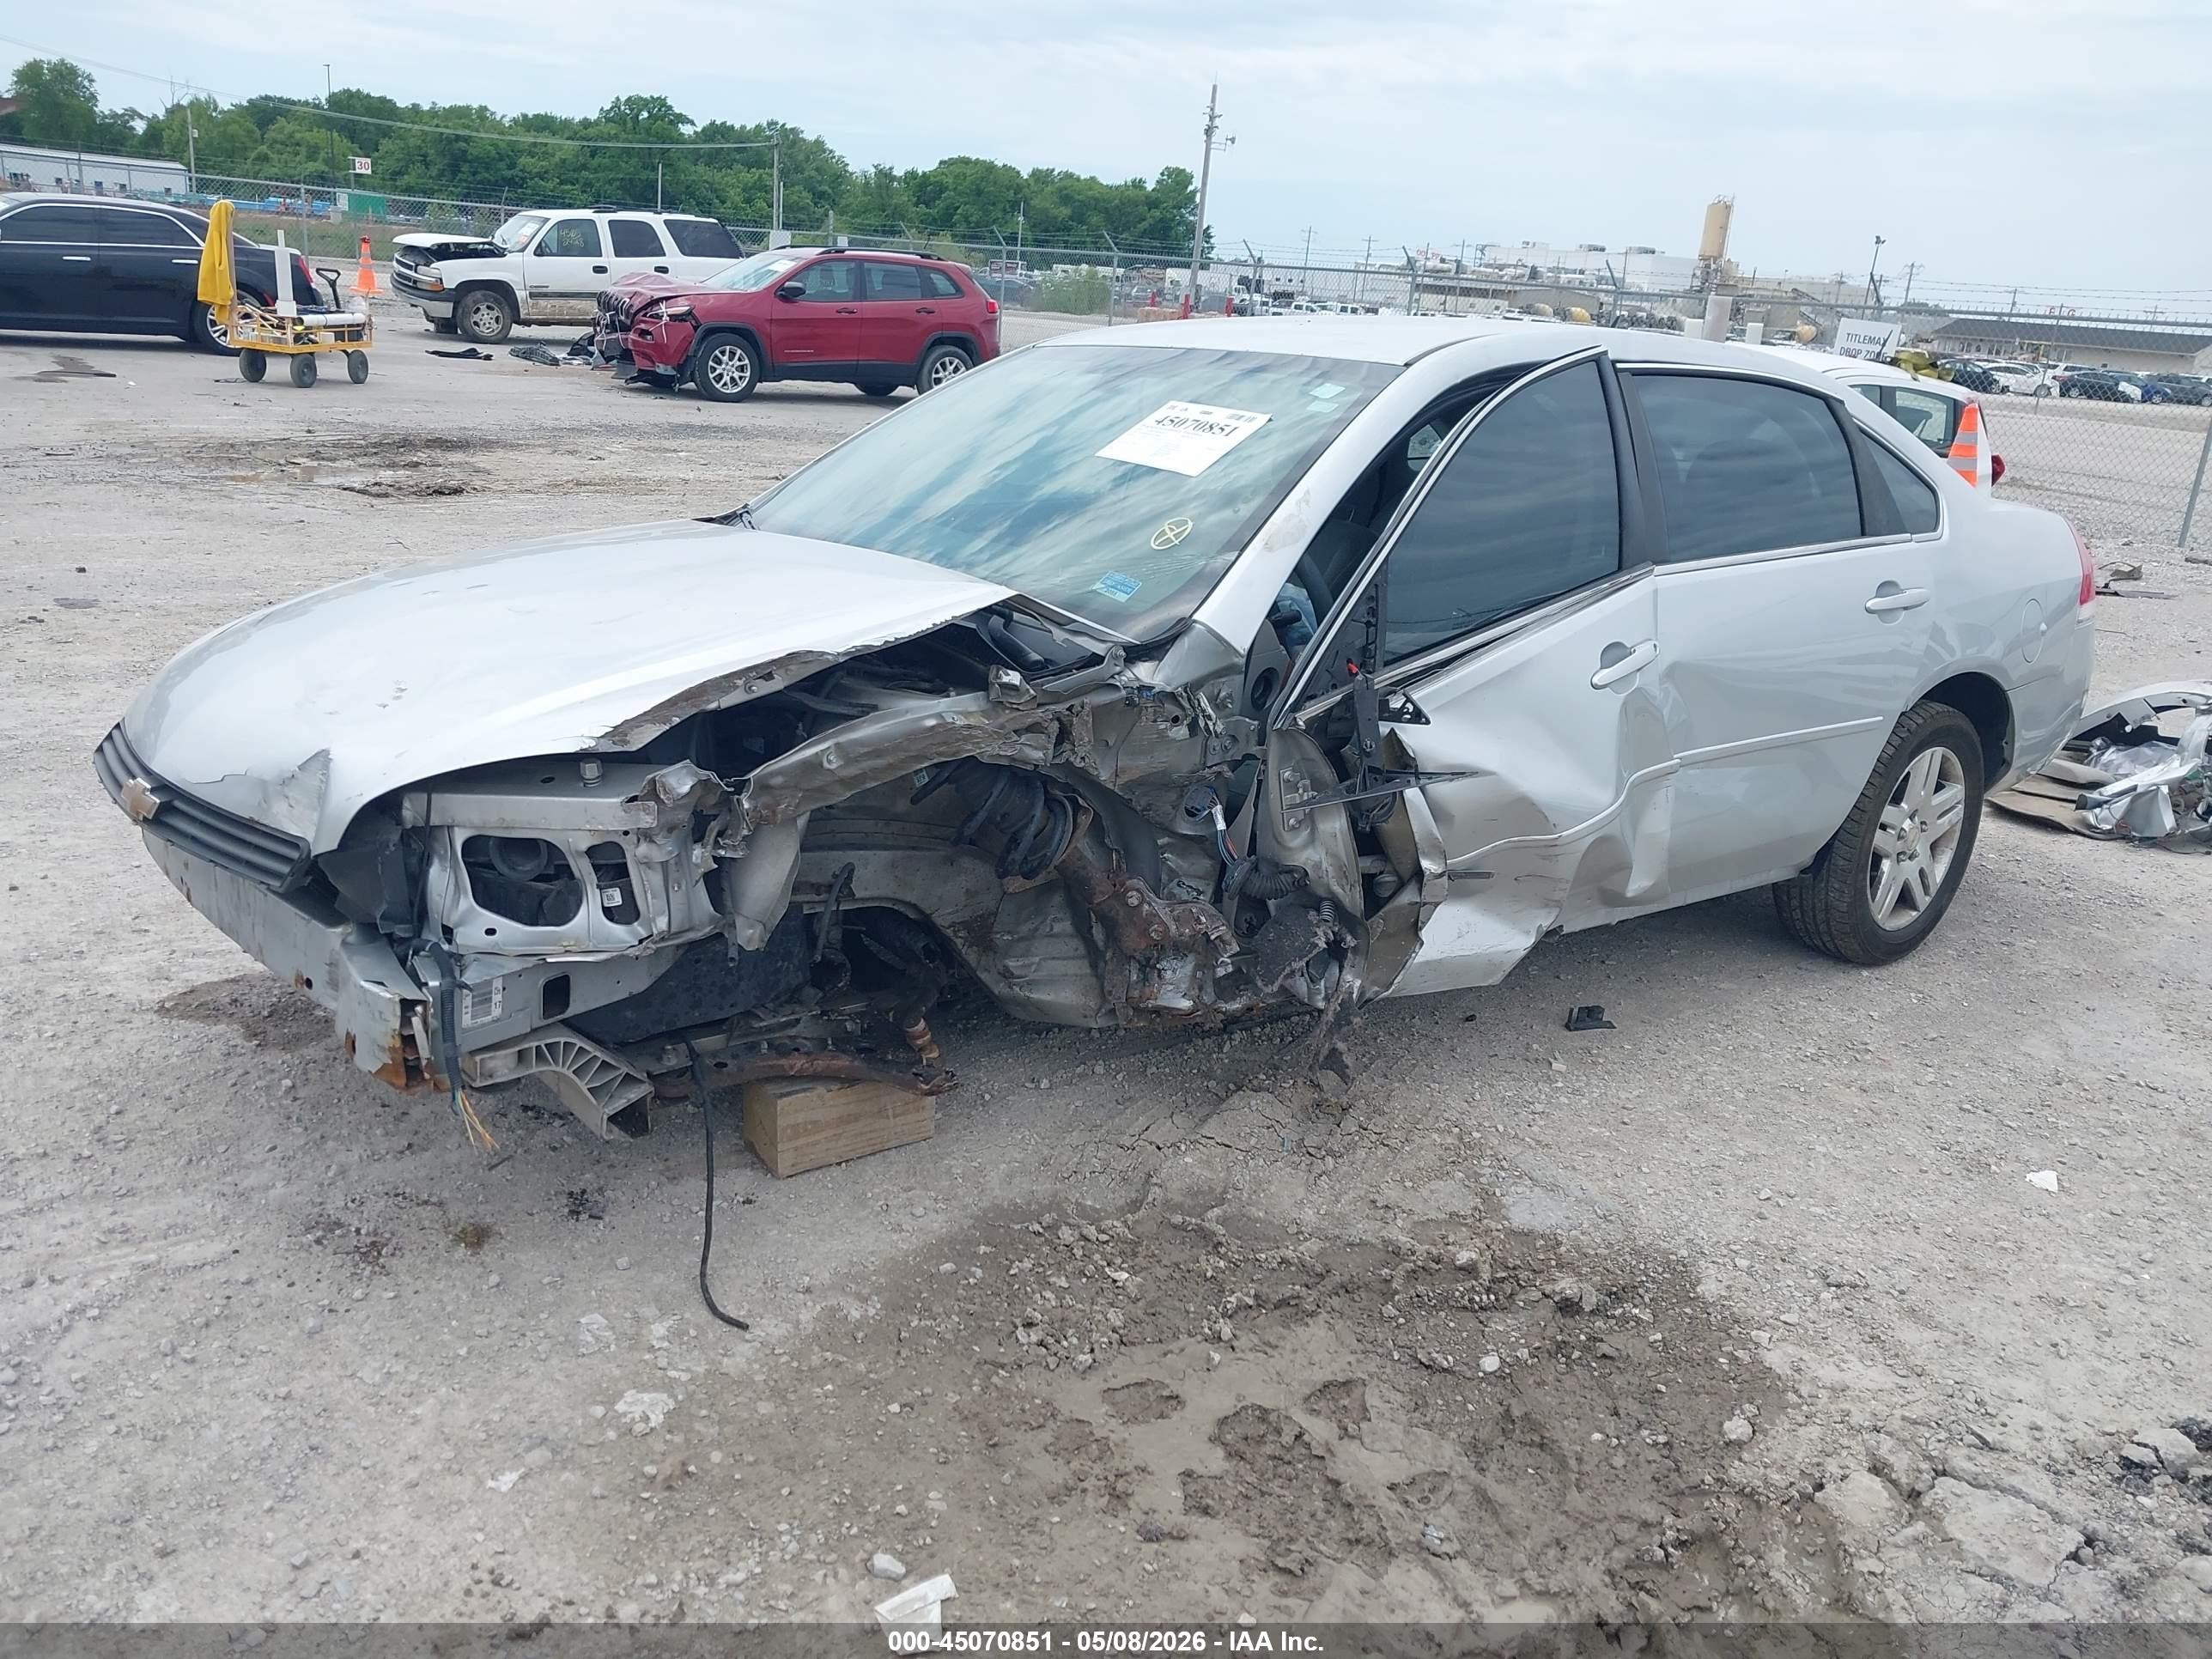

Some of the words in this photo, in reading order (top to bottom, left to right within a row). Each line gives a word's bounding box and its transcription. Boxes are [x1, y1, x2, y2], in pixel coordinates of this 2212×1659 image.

[356, 161, 370, 171] 30
[1846, 332, 1888, 347] TITLEMAX
[1839, 346, 1863, 359] DROP
[1154, 415, 1240, 437] 45070851
